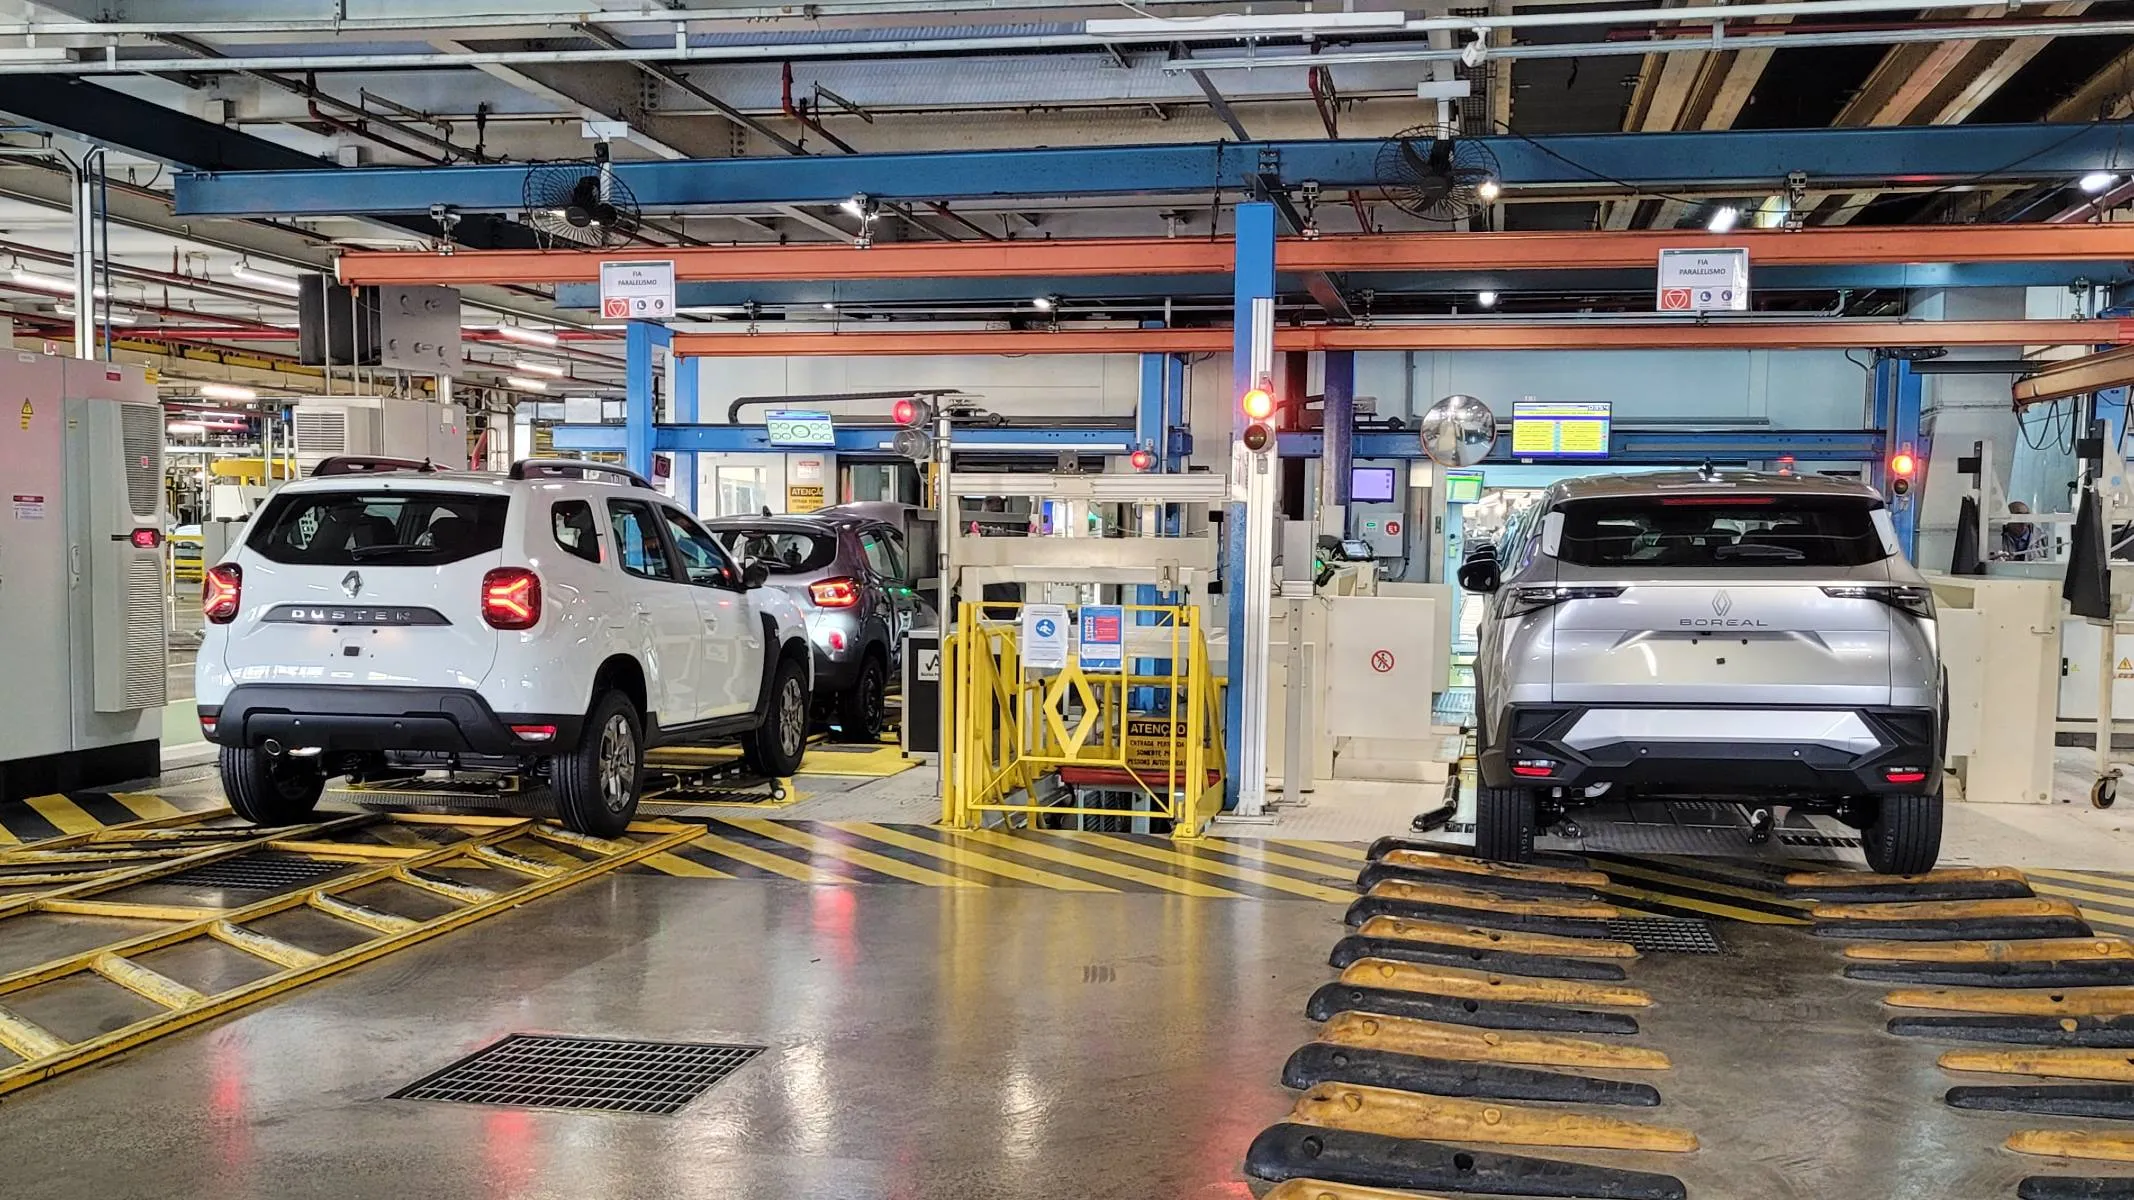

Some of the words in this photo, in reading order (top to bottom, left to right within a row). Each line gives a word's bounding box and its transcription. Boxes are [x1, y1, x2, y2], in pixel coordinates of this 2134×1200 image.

[291, 609, 412, 621] DUSTER
[1680, 618, 1769, 627] BOREAL
[1131, 723, 1186, 736] ATENÇO
